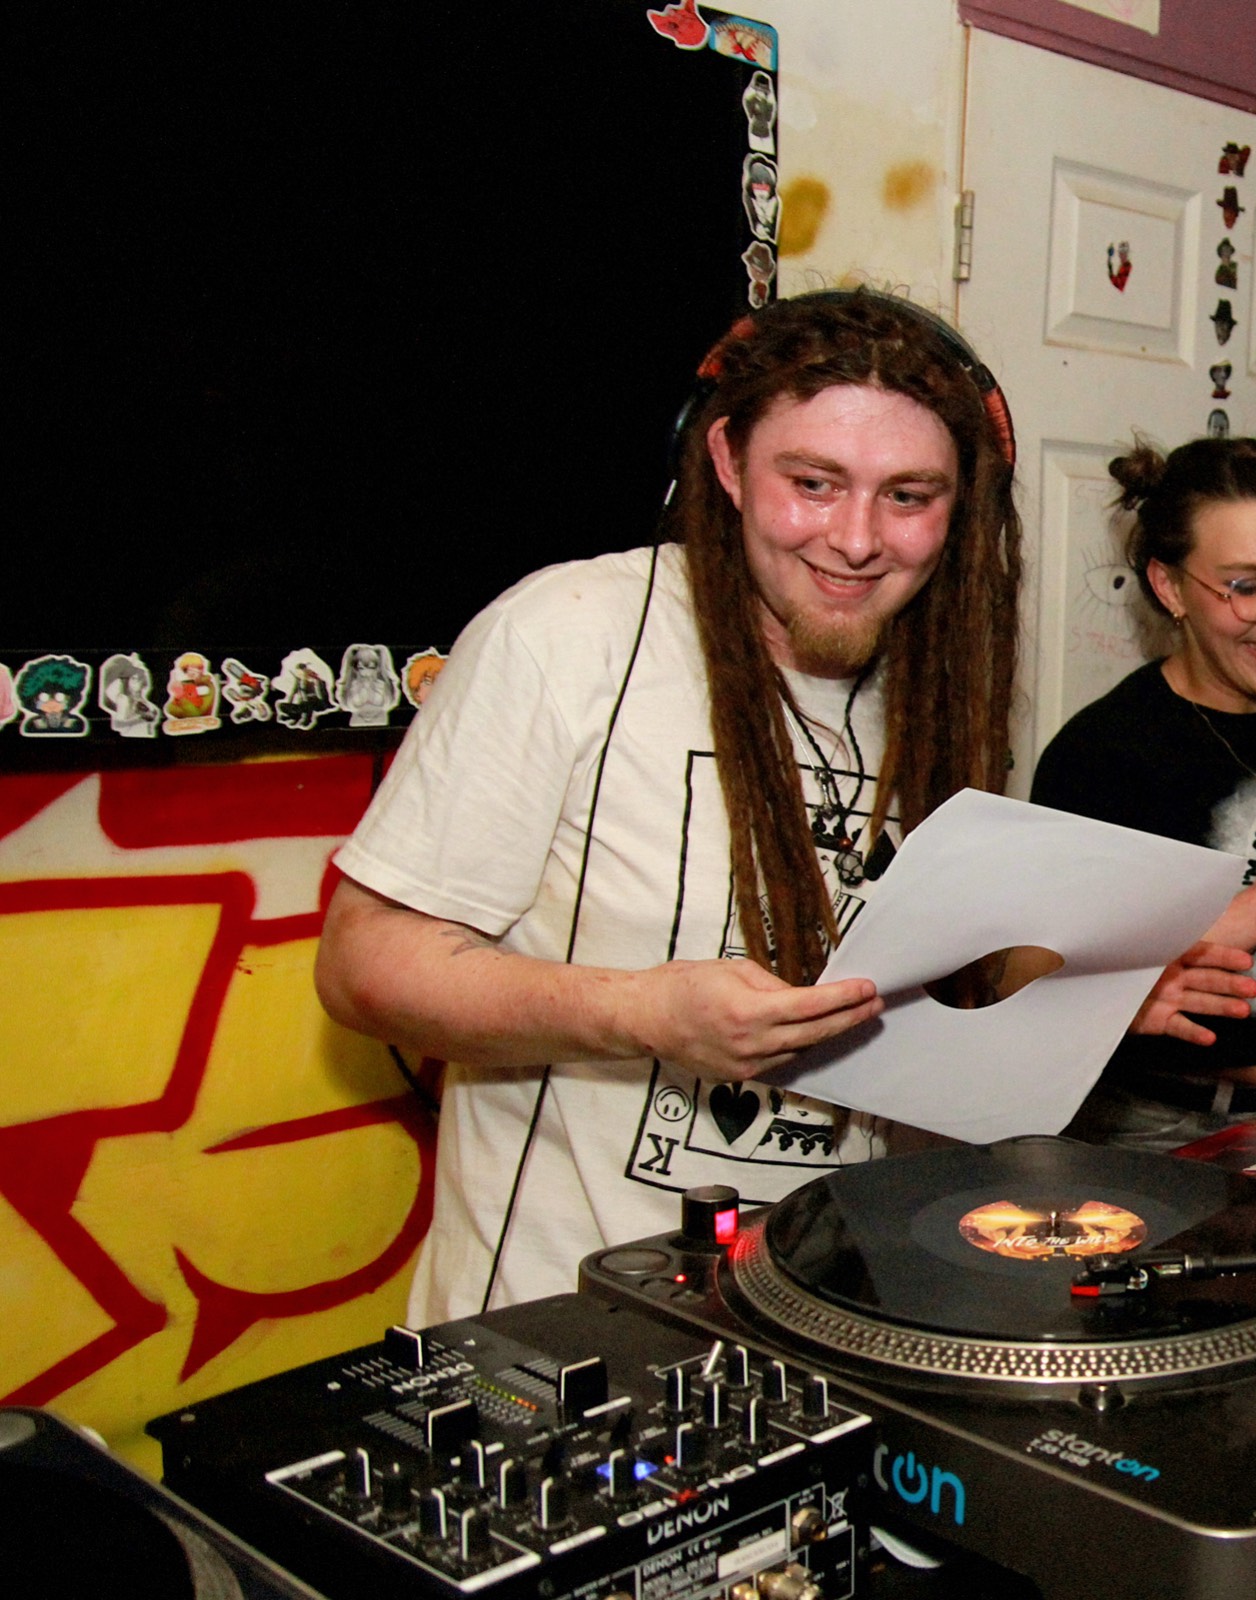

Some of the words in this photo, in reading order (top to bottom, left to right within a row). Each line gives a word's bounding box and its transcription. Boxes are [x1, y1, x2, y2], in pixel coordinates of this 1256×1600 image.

[638, 1133, 680, 1176] K
[1041, 1428, 1161, 1482] stanton
[646, 1492, 730, 1546] DENON
